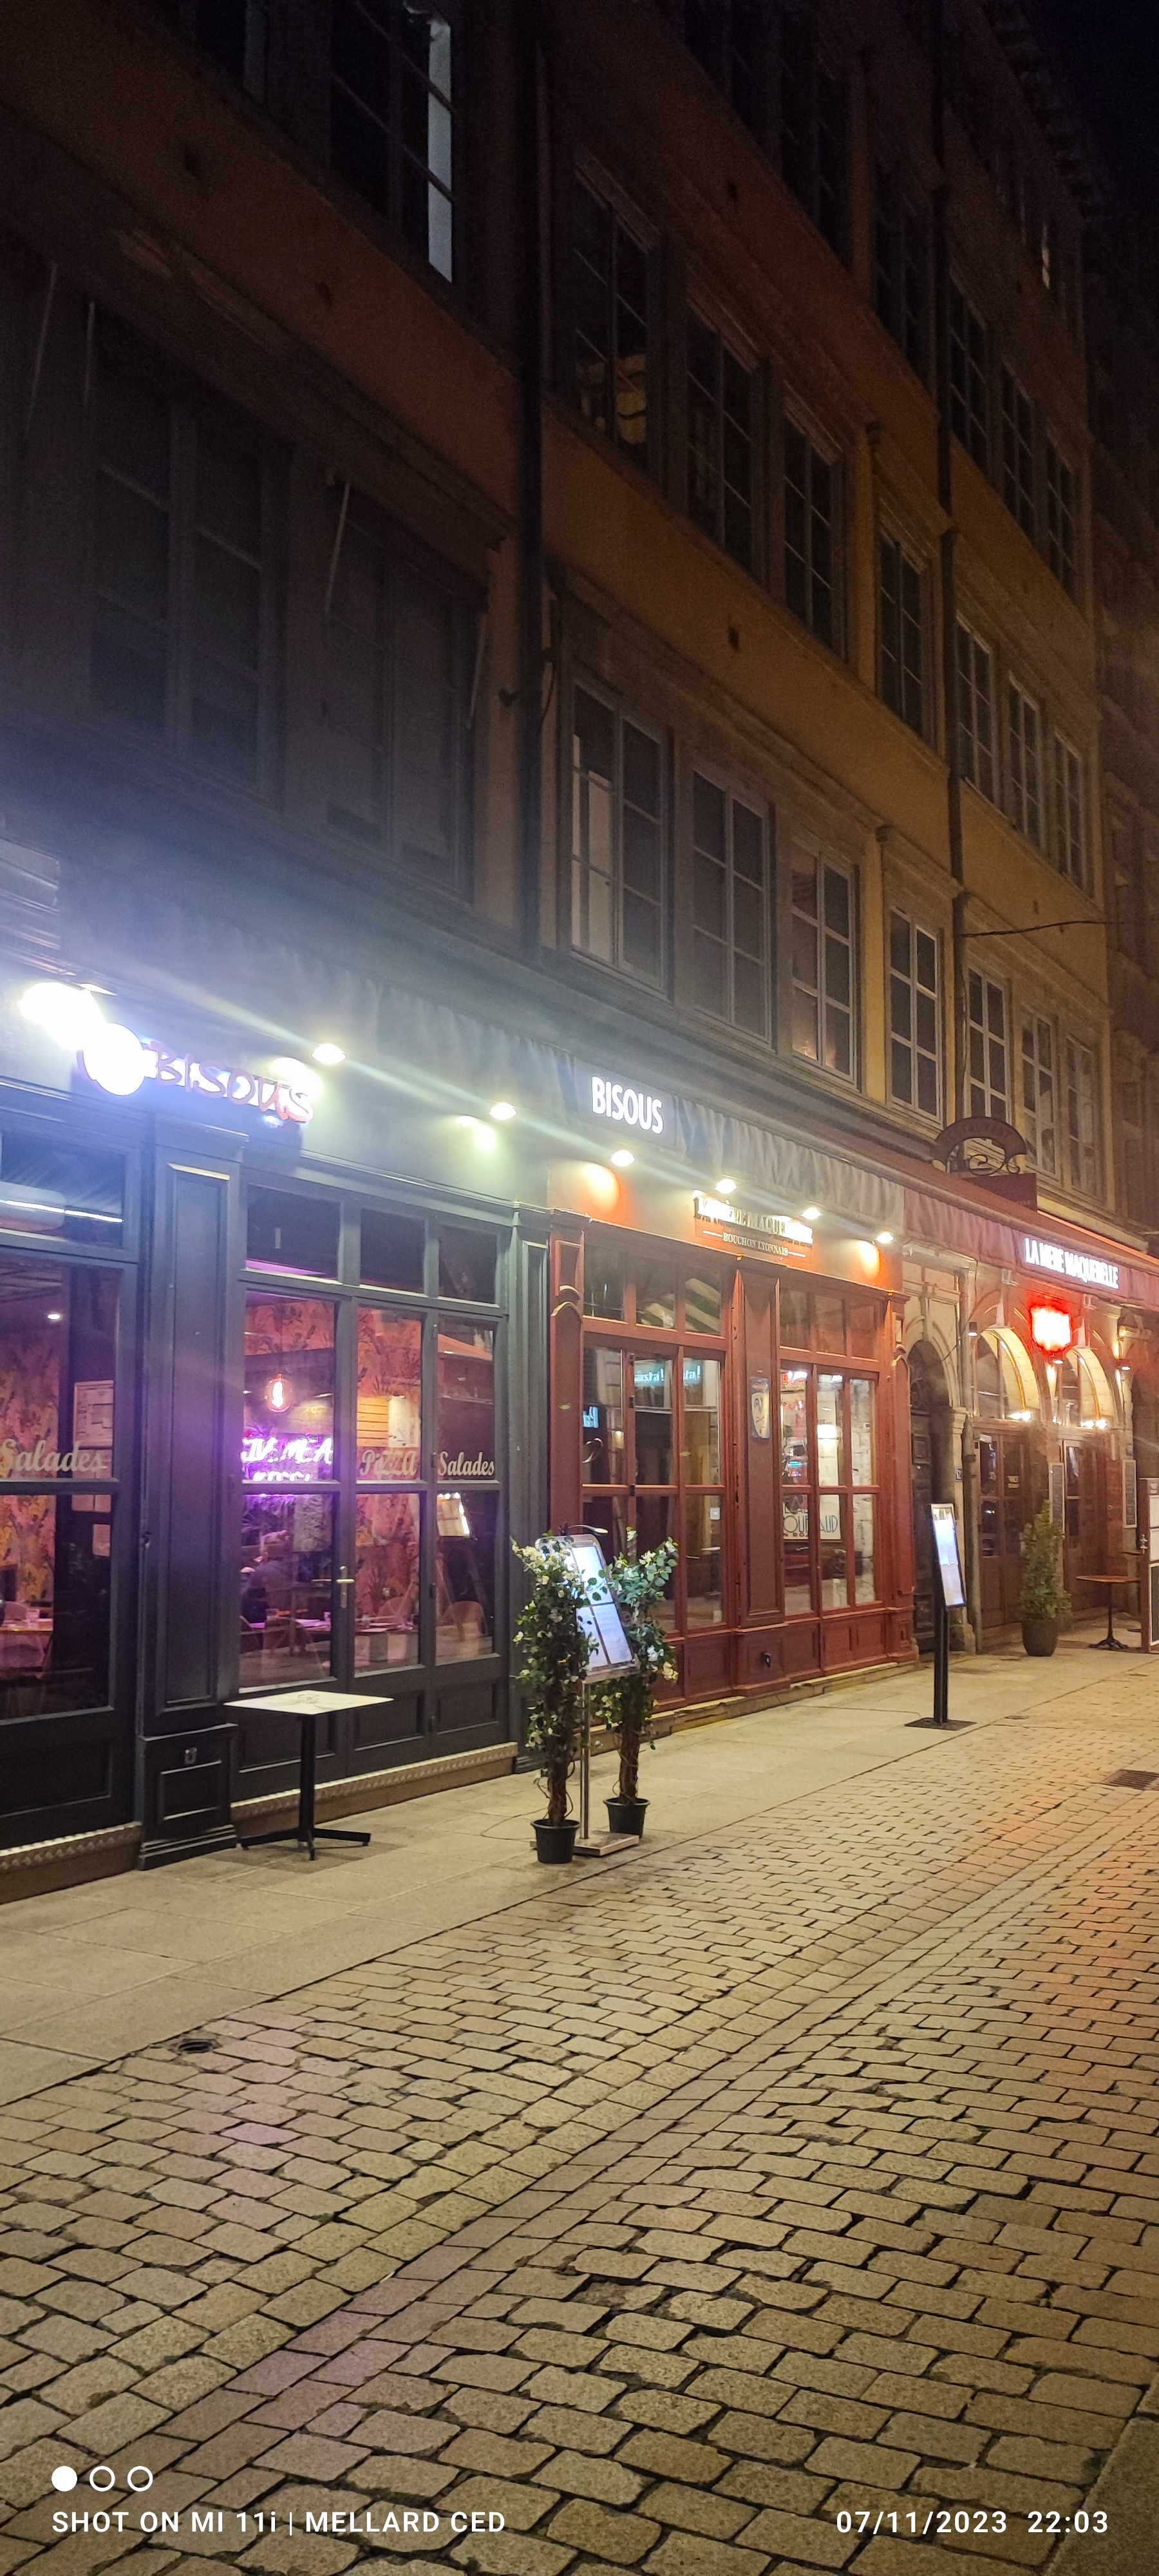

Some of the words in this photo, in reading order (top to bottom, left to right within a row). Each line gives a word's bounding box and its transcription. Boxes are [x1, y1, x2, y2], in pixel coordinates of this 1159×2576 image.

[149, 1041, 314, 1124] BISOUS
[592, 1076, 663, 1134] BISOUS
[722, 1232, 757, 1248] BOUCHON
[757, 1240, 789, 1256] LYONNAIS
[0, 1438, 104, 1472] Salades
[438, 1450, 495, 1476] Salades
